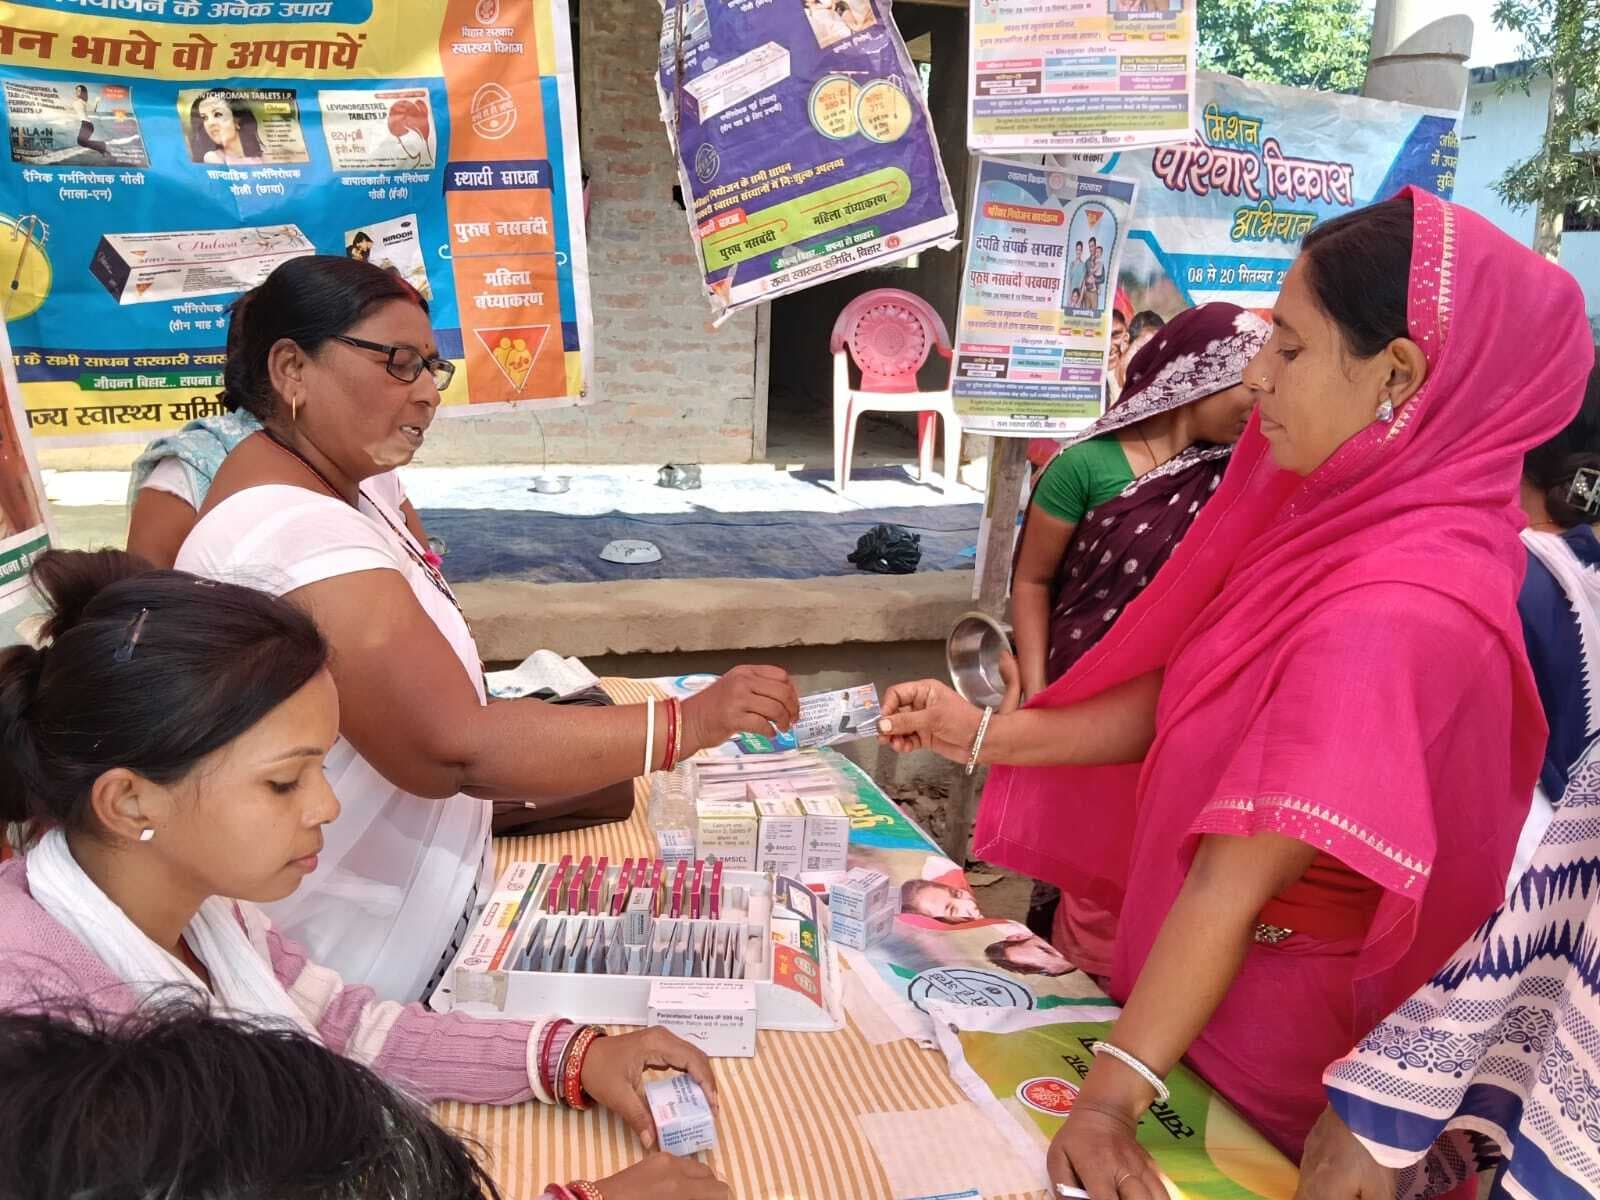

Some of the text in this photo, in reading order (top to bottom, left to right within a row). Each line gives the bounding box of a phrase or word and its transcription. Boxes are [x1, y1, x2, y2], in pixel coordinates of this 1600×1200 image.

[207, 0, 273, 18] अनेक
[278, 2, 333, 17] उपाय
[71, 30, 162, 70] भाये
[172, 33, 218, 71] वो
[226, 32, 368, 69] अपनायें
[1204, 103, 1262, 147] मिशन
[23, 169, 53, 184] दैनिक
[120, 172, 145, 185] गोली
[454, 166, 539, 186] स्थायी साधन
[1263, 137, 1355, 204] विकास
[812, 208, 842, 226] महिला
[383, 231, 413, 243] NIRODH
[454, 216, 548, 243] पुरुष नसबंदी
[1031, 243, 1065, 258] सप्ताह
[483, 268, 531, 287] महिला
[1187, 268, 1203, 282] 08
[1207, 264, 1216, 282] से
[1219, 269, 1234, 284] 20
[45, 352, 80, 367] सभी
[84, 356, 129, 367] साधन
[133, 352, 190, 368] सरकारी
[75, 403, 162, 426] स्वास्थ्य
